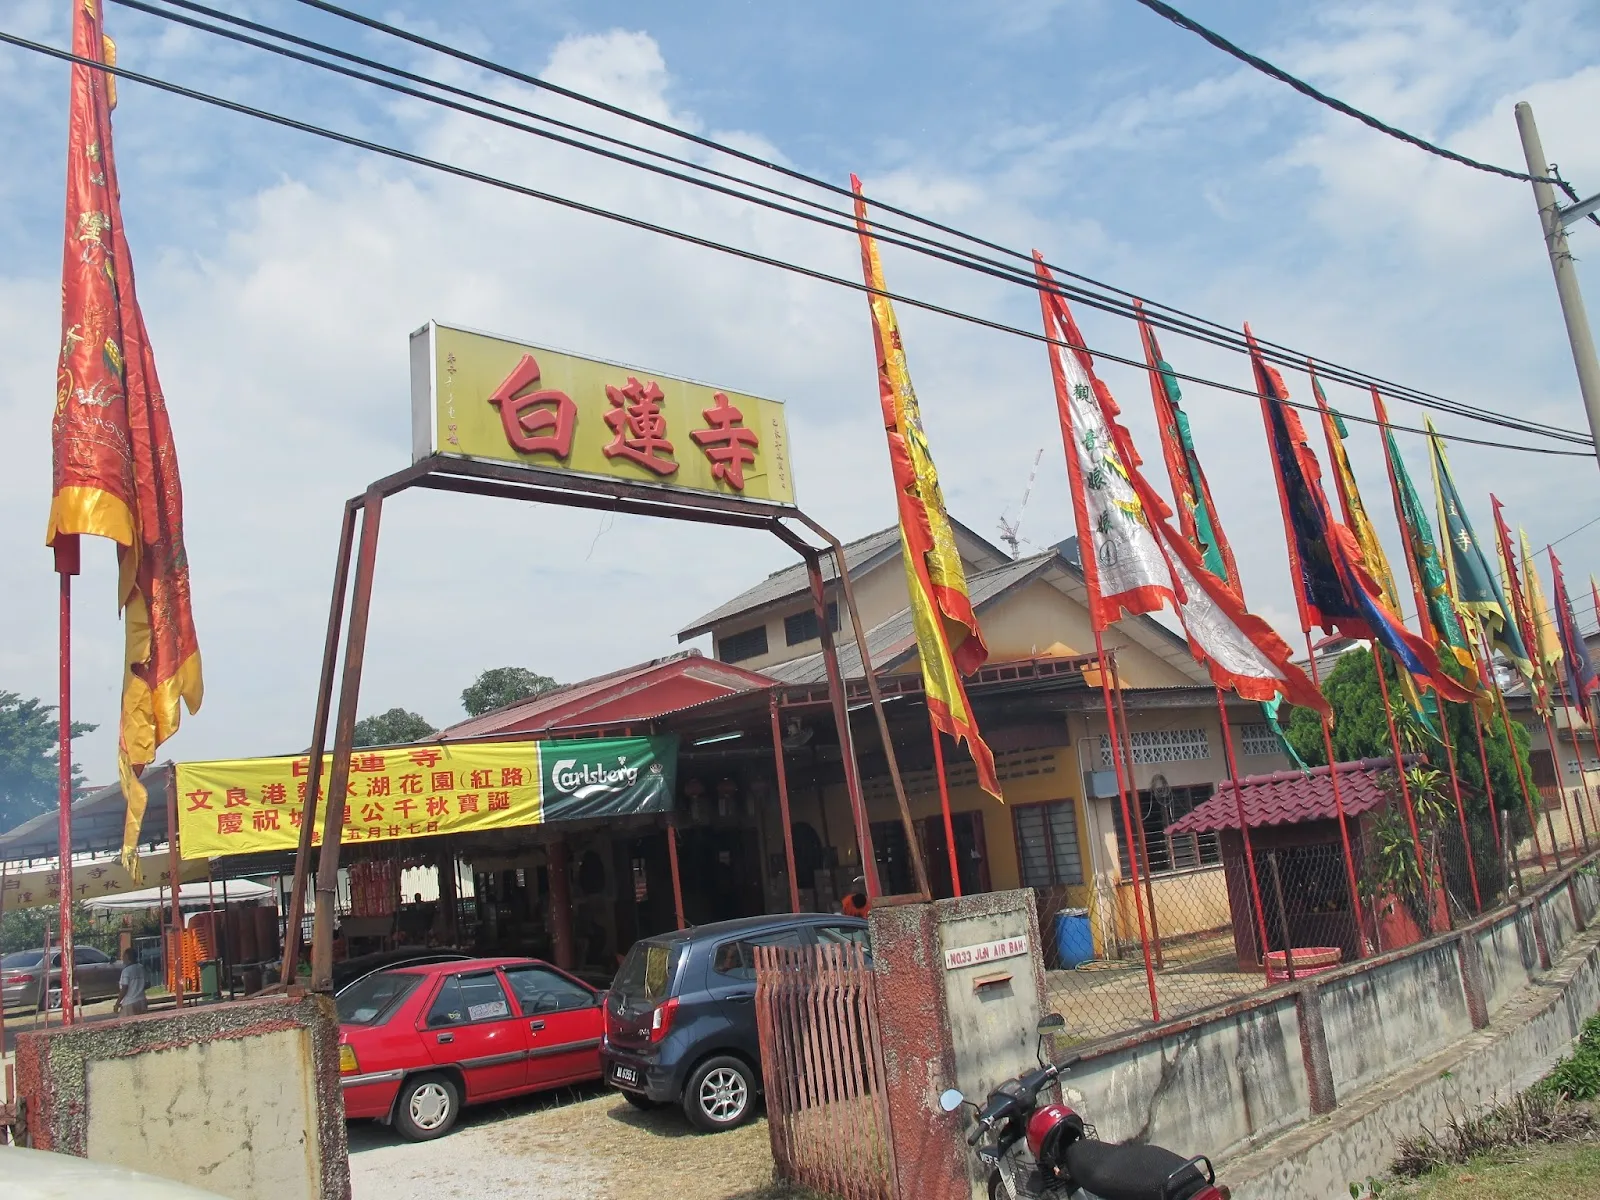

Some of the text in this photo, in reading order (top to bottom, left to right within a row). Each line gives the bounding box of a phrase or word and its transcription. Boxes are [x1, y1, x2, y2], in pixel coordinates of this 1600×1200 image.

[488, 353, 759, 492] 白蓮寺
[1073, 383, 1115, 535] 觀音娘娘
[552, 759, 638, 793] Carlsberg
[993, 943, 1007, 958] AIR
